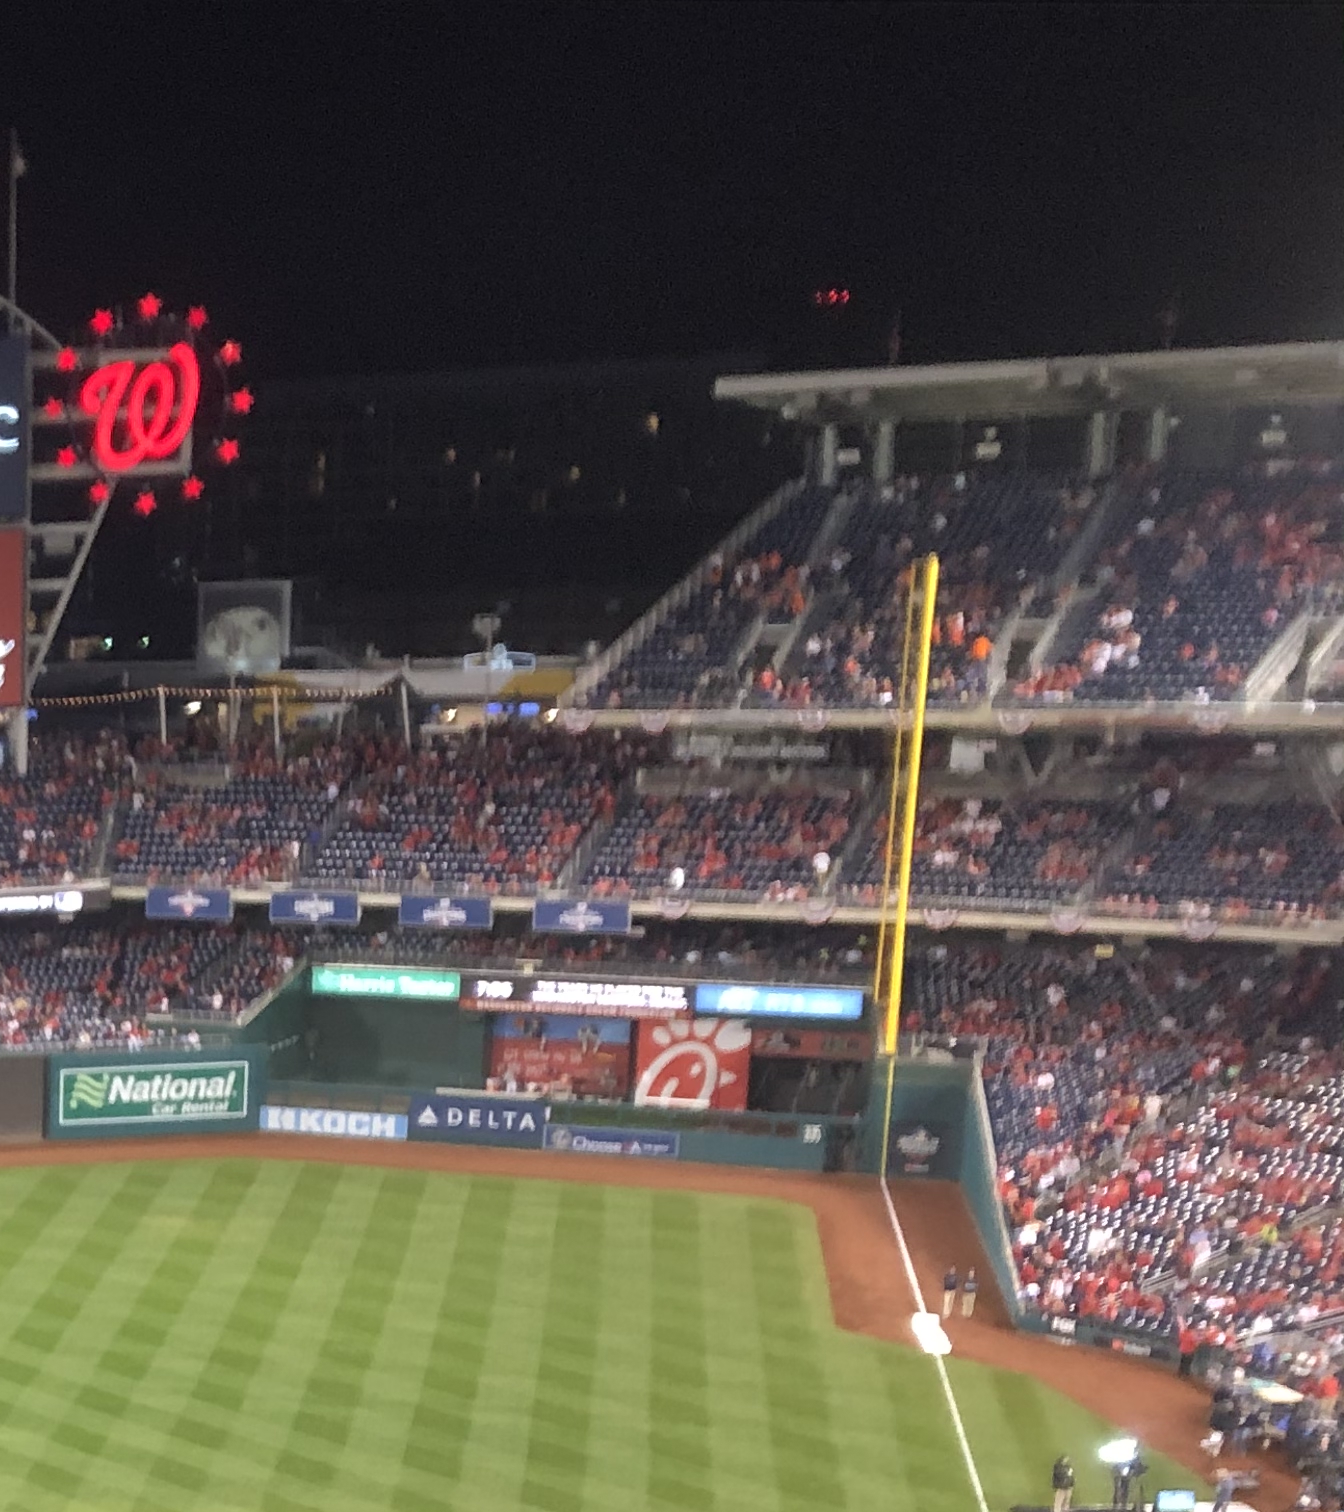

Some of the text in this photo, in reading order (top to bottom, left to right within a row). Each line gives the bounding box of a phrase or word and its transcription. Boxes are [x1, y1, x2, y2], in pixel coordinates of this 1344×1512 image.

[108, 1071, 238, 1104] National
[298, 1108, 396, 1138] KOCH
[446, 1106, 537, 1133] DELTA
